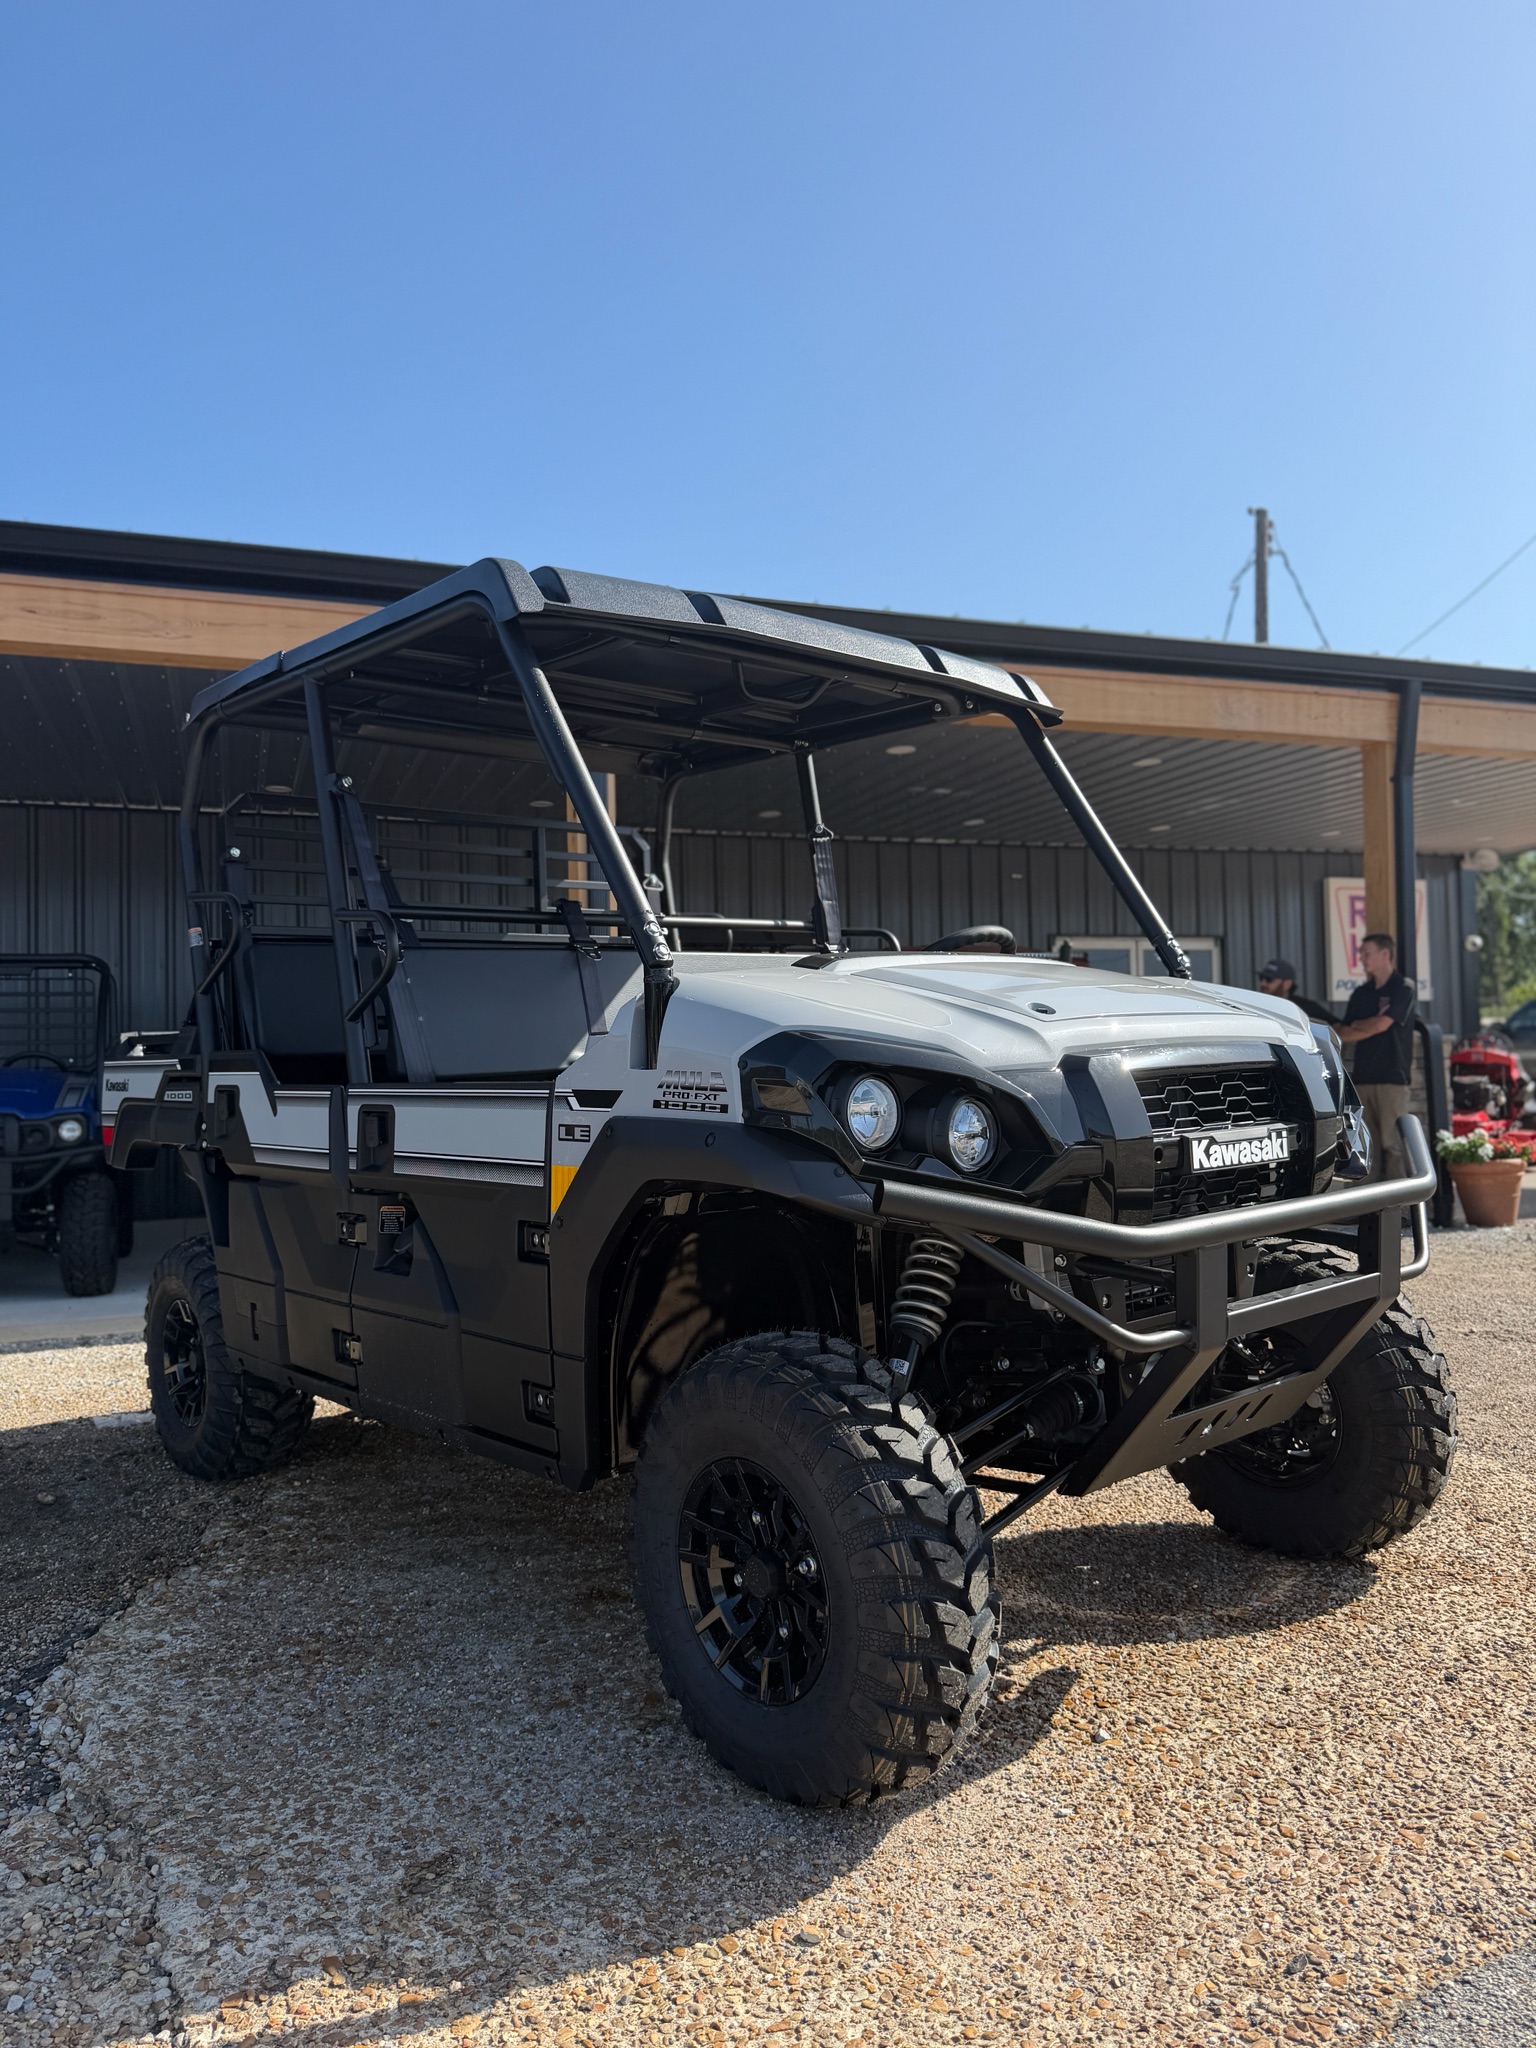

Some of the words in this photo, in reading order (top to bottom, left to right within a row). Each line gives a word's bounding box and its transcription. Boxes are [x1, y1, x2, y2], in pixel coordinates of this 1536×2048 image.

[105, 1079, 130, 1092] Kawasaki
[657, 1070, 728, 1092] MULE
[660, 1100, 721, 1113] 1000
[559, 1126, 591, 1141] LE
[1191, 1130, 1289, 1170] Kawasaki
